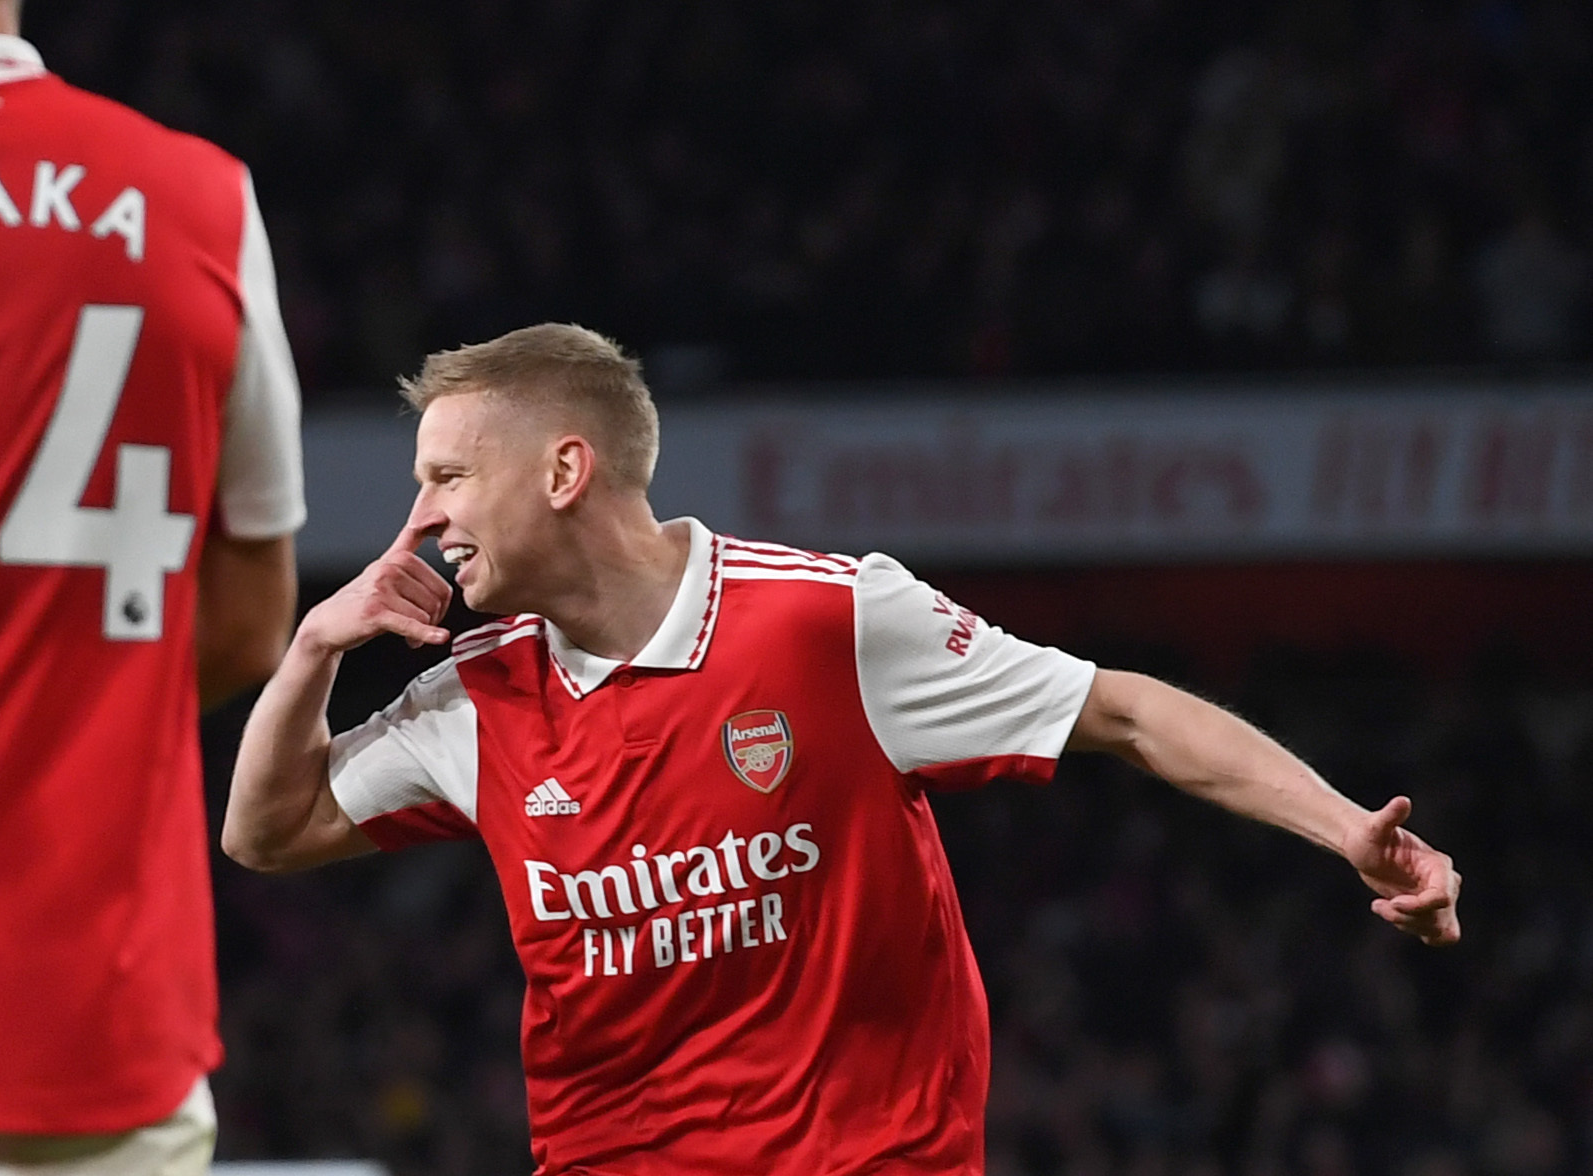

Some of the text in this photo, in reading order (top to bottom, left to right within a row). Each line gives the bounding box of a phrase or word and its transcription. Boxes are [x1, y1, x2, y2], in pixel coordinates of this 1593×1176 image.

[732, 721, 782, 742] Arsenal
[525, 800, 581, 817] adidas
[524, 822, 821, 923] Emirates
[583, 892, 787, 977] FLY BETTER
